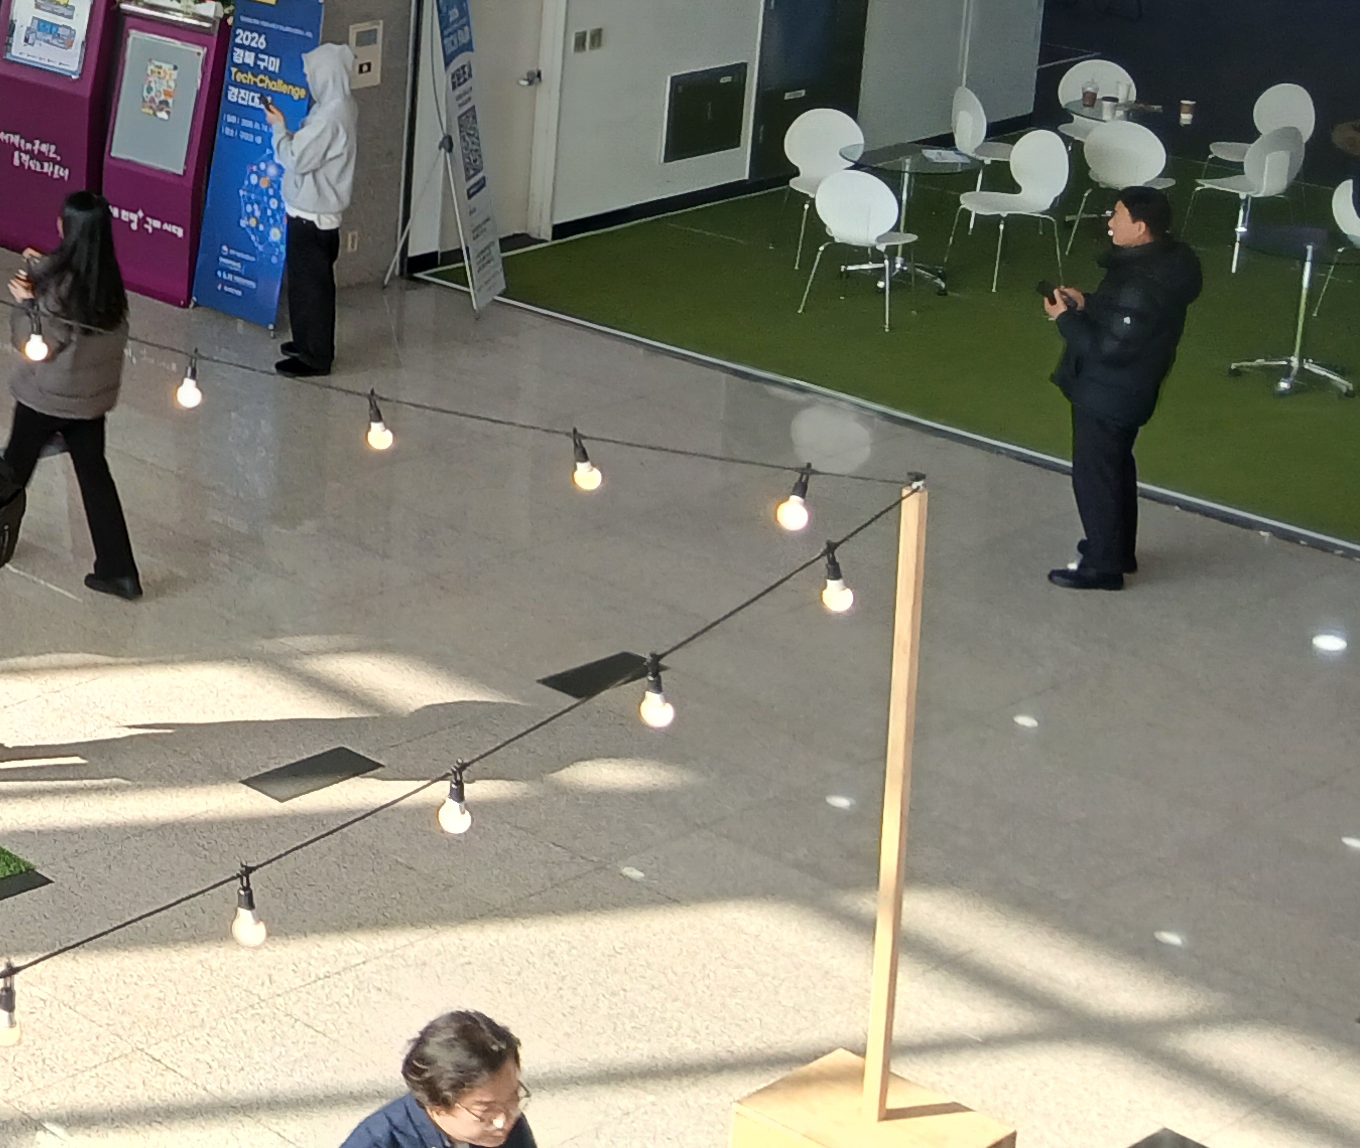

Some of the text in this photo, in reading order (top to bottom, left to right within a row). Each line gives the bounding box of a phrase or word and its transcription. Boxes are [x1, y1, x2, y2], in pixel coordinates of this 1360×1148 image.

[235, 28, 267, 50] 2026
[257, 54, 280, 74] 구미
[230, 66, 308, 101] Tech-Challenge
